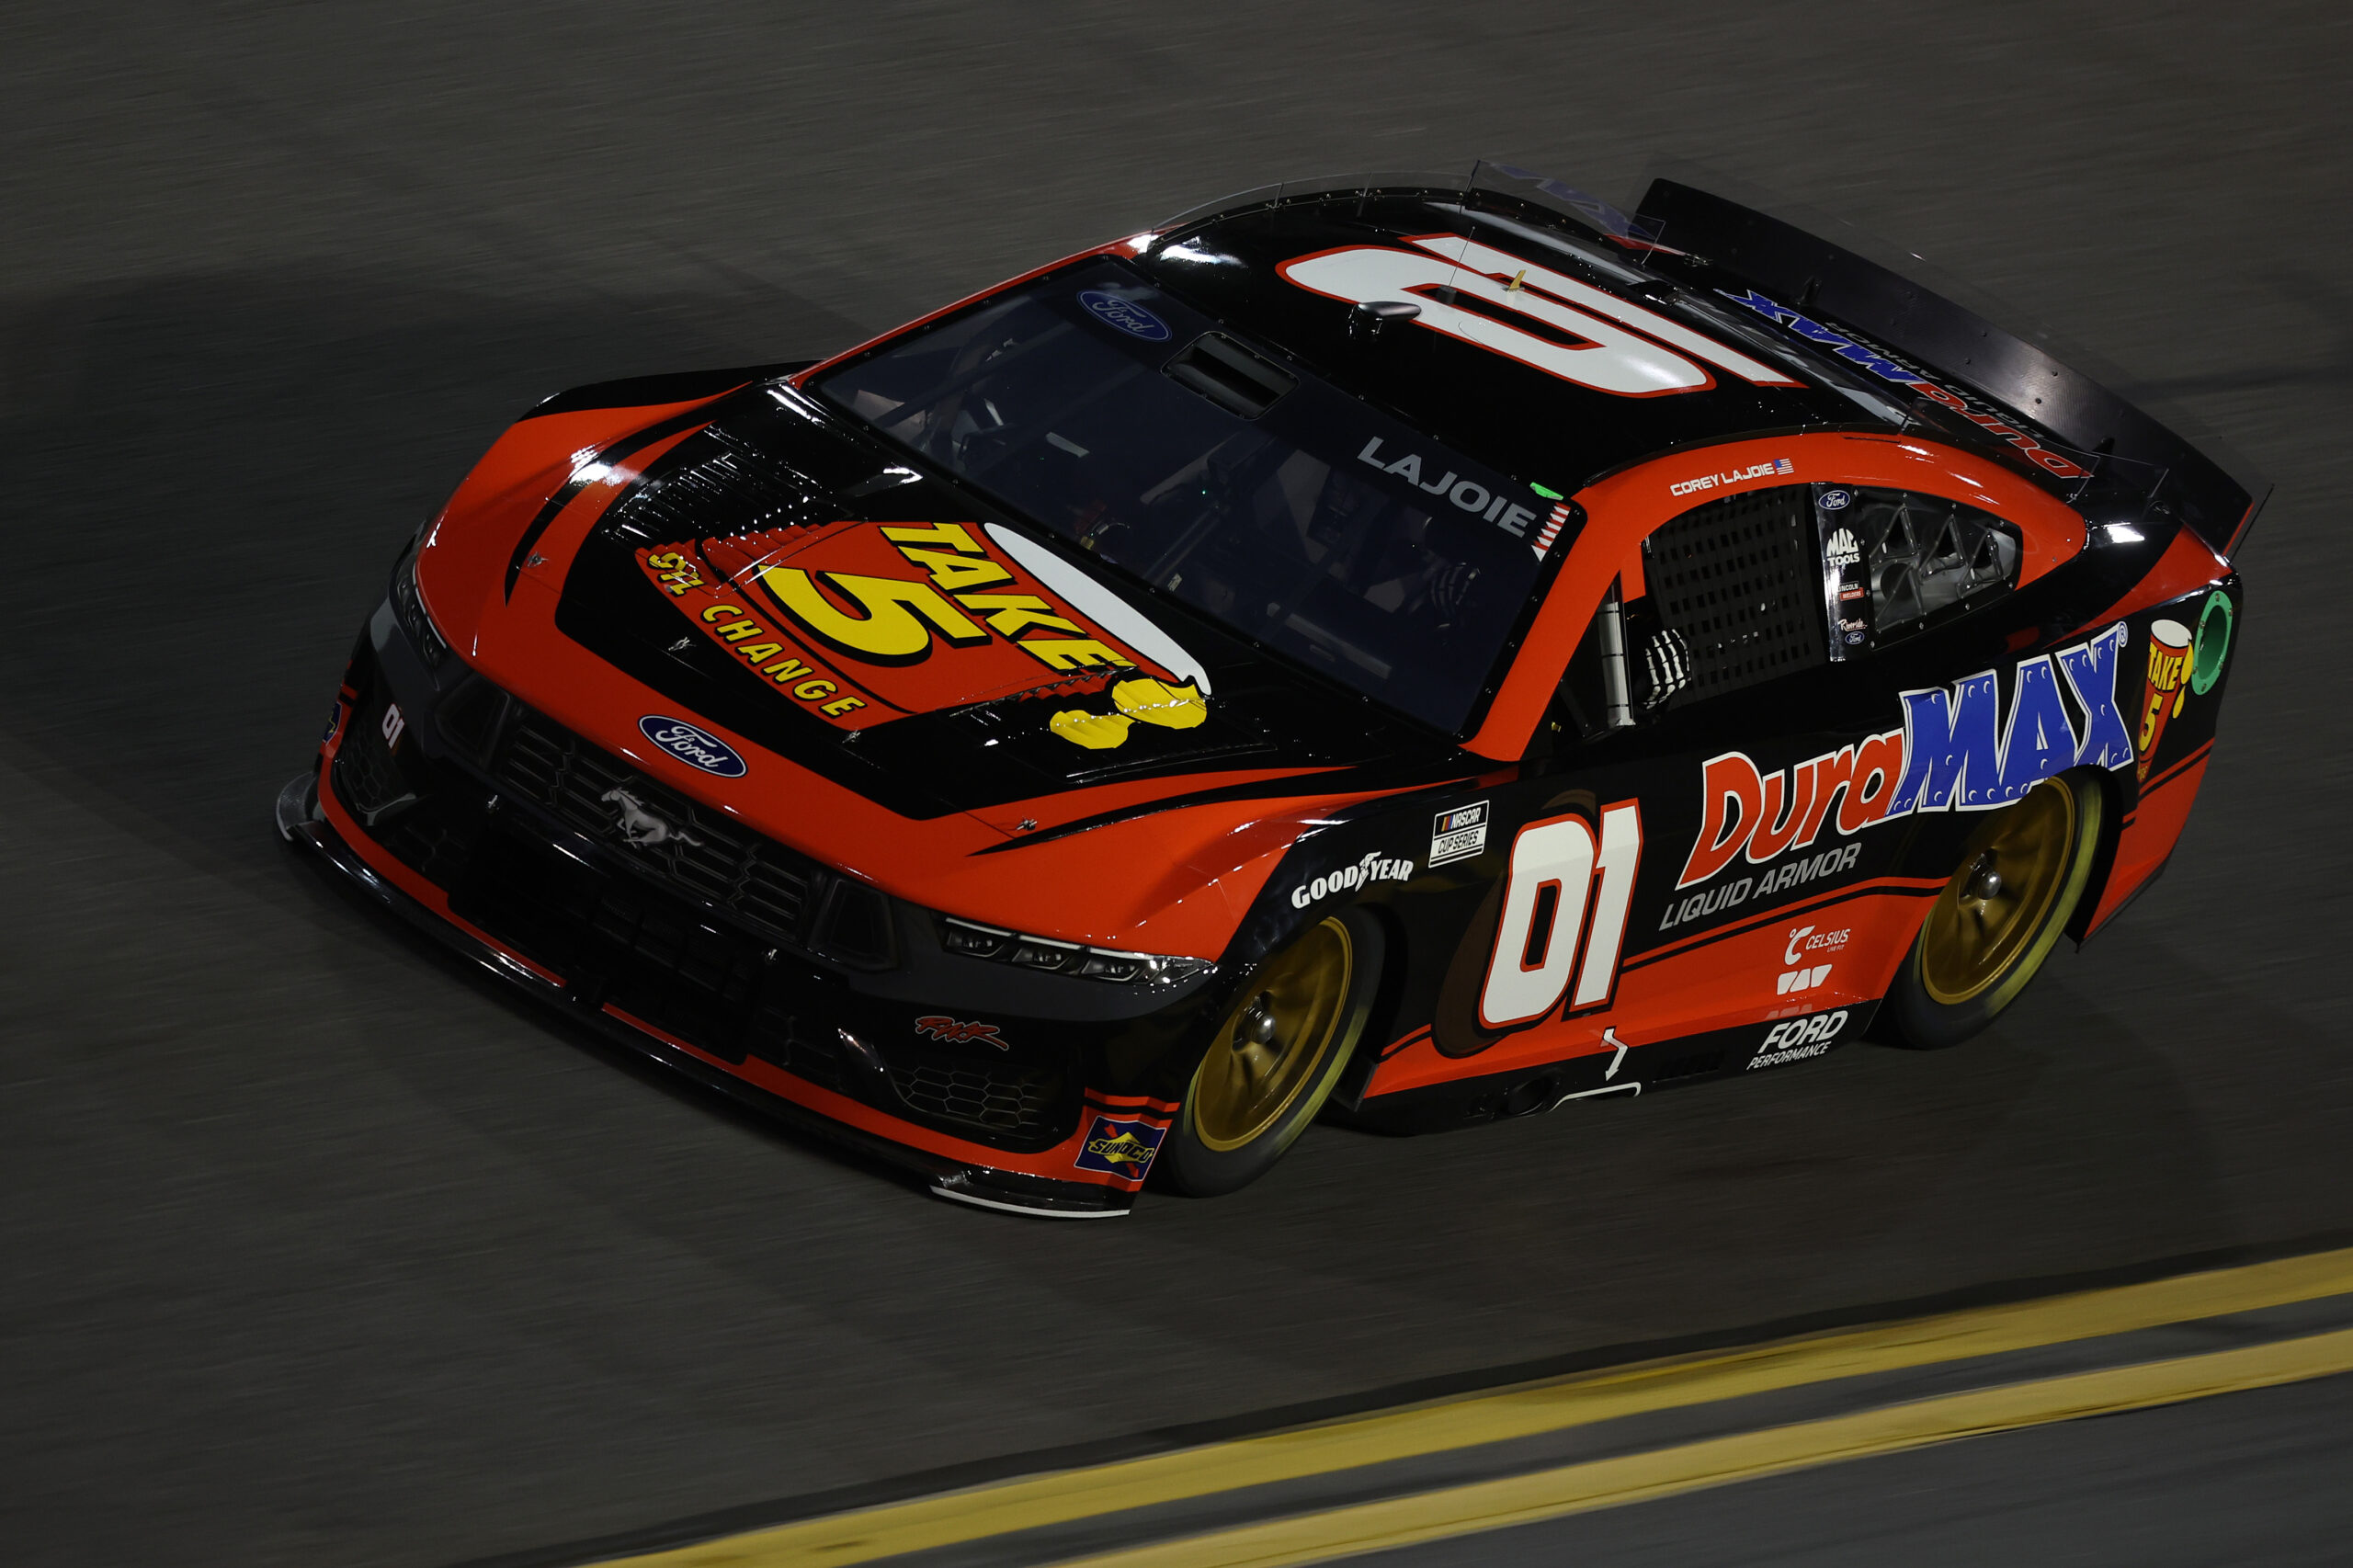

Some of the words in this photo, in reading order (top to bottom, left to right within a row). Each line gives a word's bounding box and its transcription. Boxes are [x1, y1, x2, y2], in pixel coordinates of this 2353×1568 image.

[1090, 297, 1156, 334] Ford
[1275, 232, 1809, 398] 01
[1824, 321, 1942, 381] ARMOR
[1946, 383, 2047, 442] LIQUID
[1357, 436, 1537, 539] LAJOIE
[1669, 472, 1720, 496] COREY
[1722, 462, 1775, 484] LAJOIE
[1825, 528, 1859, 557] MAC
[1826, 552, 1860, 567] TOOLS
[756, 563, 991, 665] 5
[878, 522, 1140, 671] TAKE
[700, 604, 868, 719] CHANGE
[2147, 641, 2184, 692] TAKE
[381, 702, 405, 749] 01
[654, 724, 733, 769] Ford
[2139, 691, 2164, 754] 5
[1438, 836, 1454, 854] CUP
[1453, 830, 1479, 850] SERIES
[1449, 805, 1482, 830] NASCAR
[1290, 851, 1415, 910] GOODYEAR
[1658, 876, 1754, 931] LIQUID
[1752, 842, 1862, 901] ARMOR
[1477, 797, 1644, 1030] 01
[1805, 927, 1851, 950] CELSIUS
[1745, 1040, 1832, 1072] PERFORMANCE
[1757, 1010, 1849, 1054] FORD
[1088, 1138, 1155, 1164] SUNOCO
